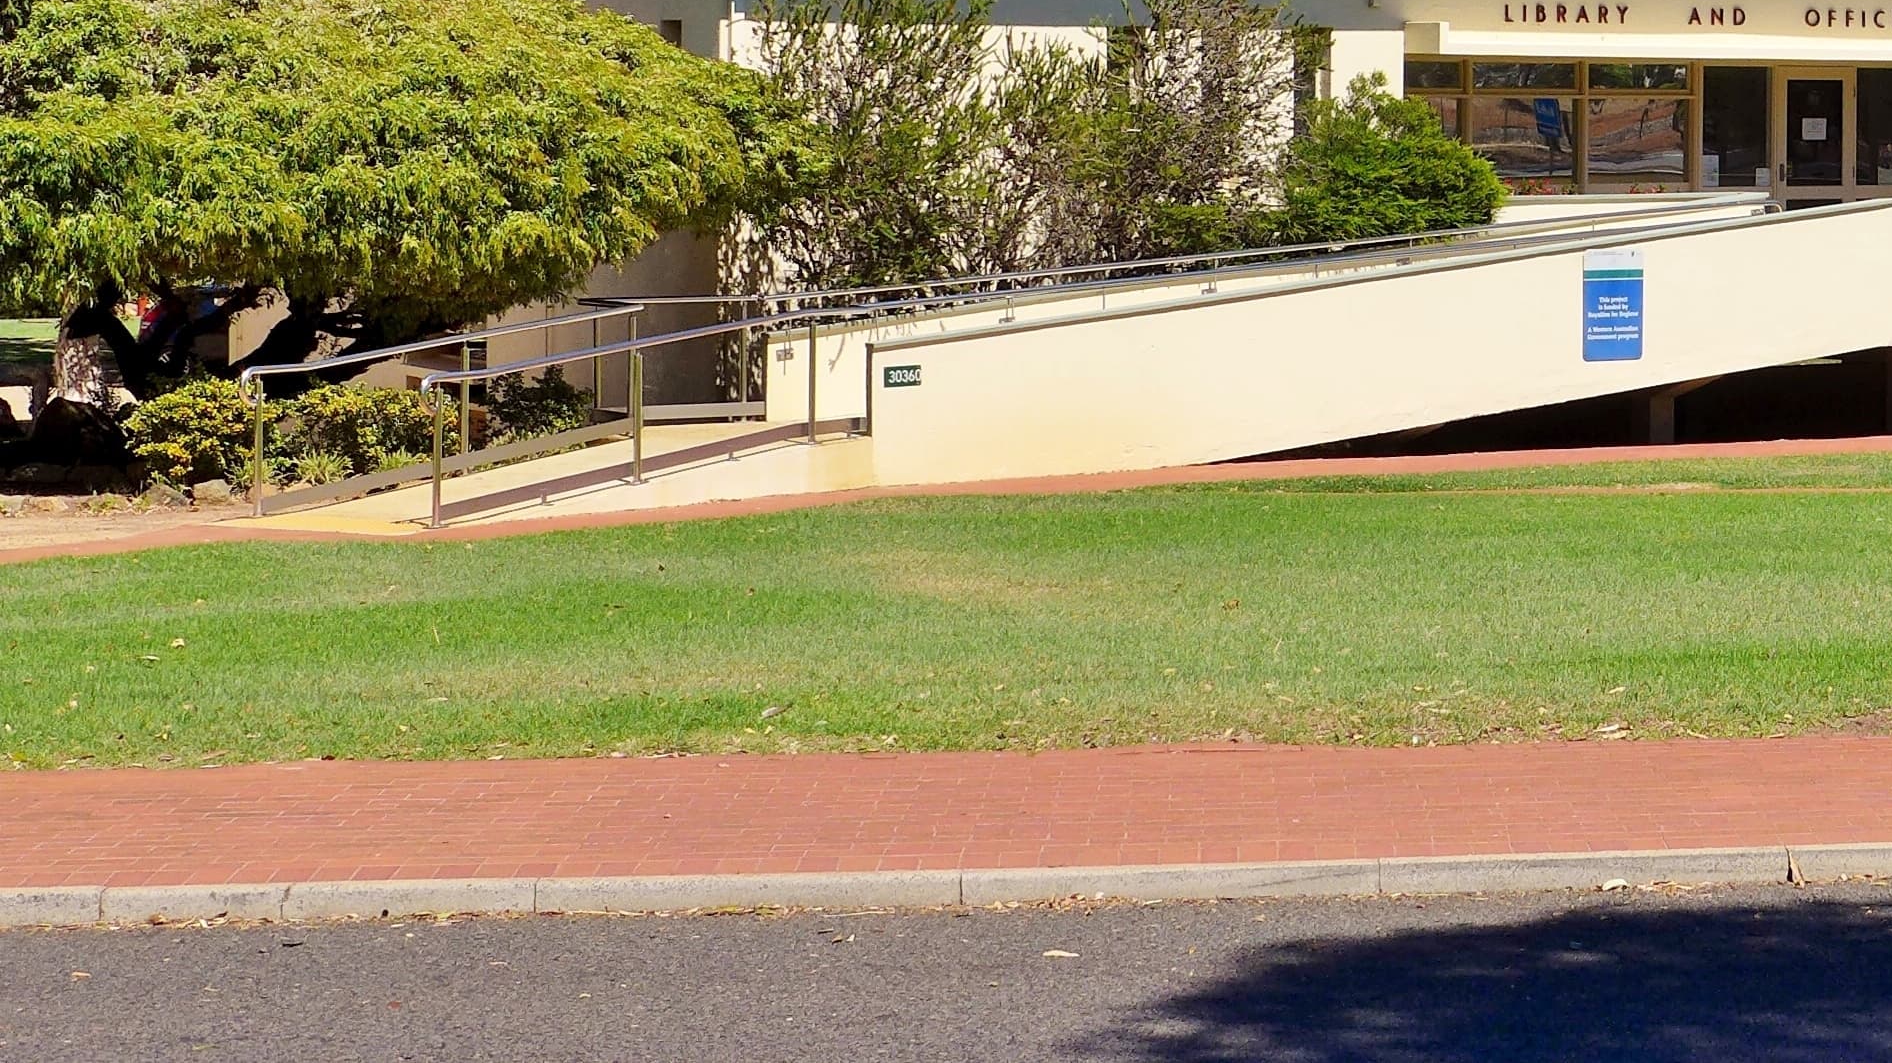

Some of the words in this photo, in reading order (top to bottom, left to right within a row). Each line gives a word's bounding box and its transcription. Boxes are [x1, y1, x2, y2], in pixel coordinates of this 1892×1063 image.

[1504, 4, 1629, 24] LIBRARY
[1688, 7, 1746, 27] AND
[888, 369, 921, 383] 30360
